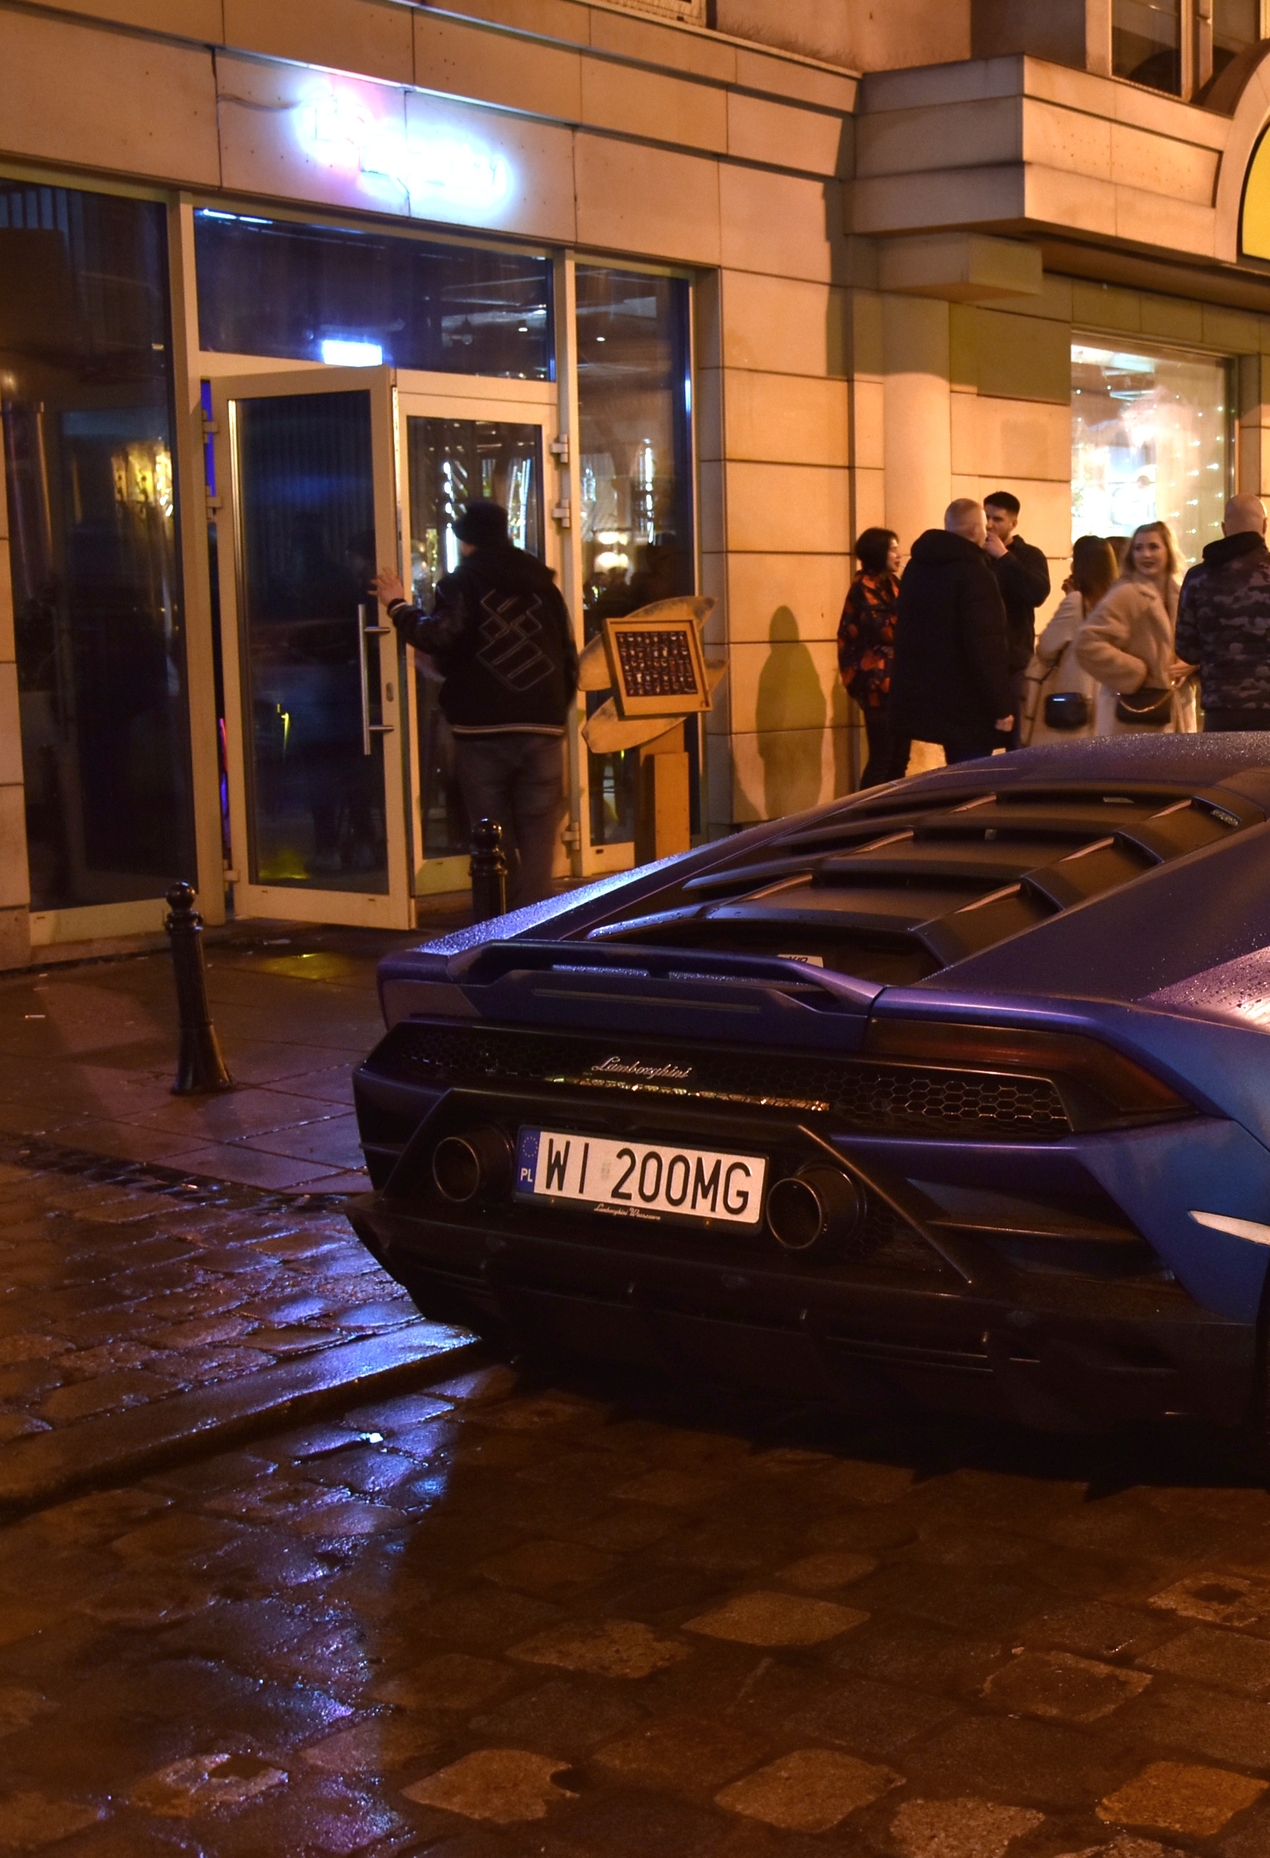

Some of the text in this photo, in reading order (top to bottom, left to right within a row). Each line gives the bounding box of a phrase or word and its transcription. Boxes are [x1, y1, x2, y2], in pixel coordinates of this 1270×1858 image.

[591, 1055, 693, 1080] Lamborghini
[520, 1168, 533, 1183] PL
[545, 1138, 752, 1215] WI 200MG
